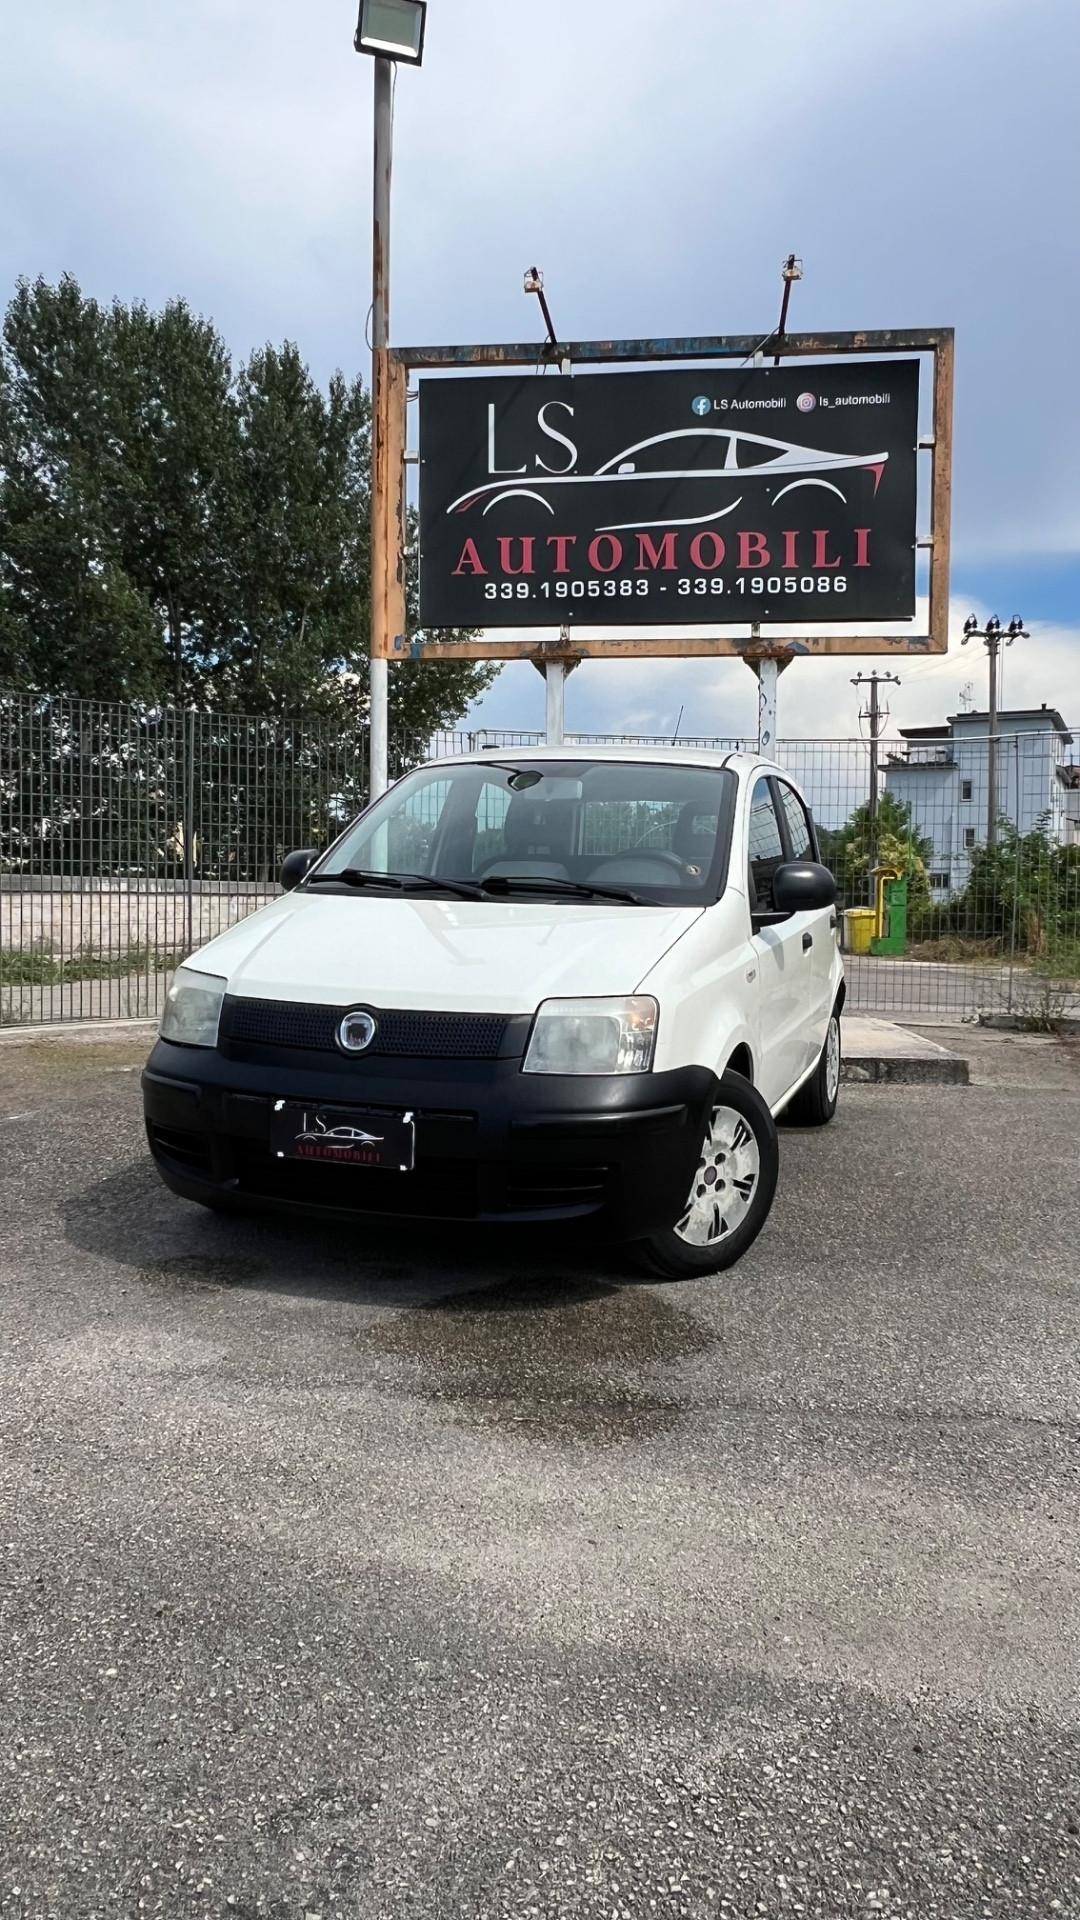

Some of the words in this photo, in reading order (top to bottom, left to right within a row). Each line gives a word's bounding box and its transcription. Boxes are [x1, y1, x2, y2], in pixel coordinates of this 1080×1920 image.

[713, 399, 728, 410] LS
[732, 398, 786, 409] Automobili
[819, 394, 890, 409] ls_automobili
[487, 401, 578, 475] LS
[452, 528, 872, 575] AUTOMOBILI
[484, 580, 650, 600] 339.1905383
[677, 576, 848, 596] 339.1905086
